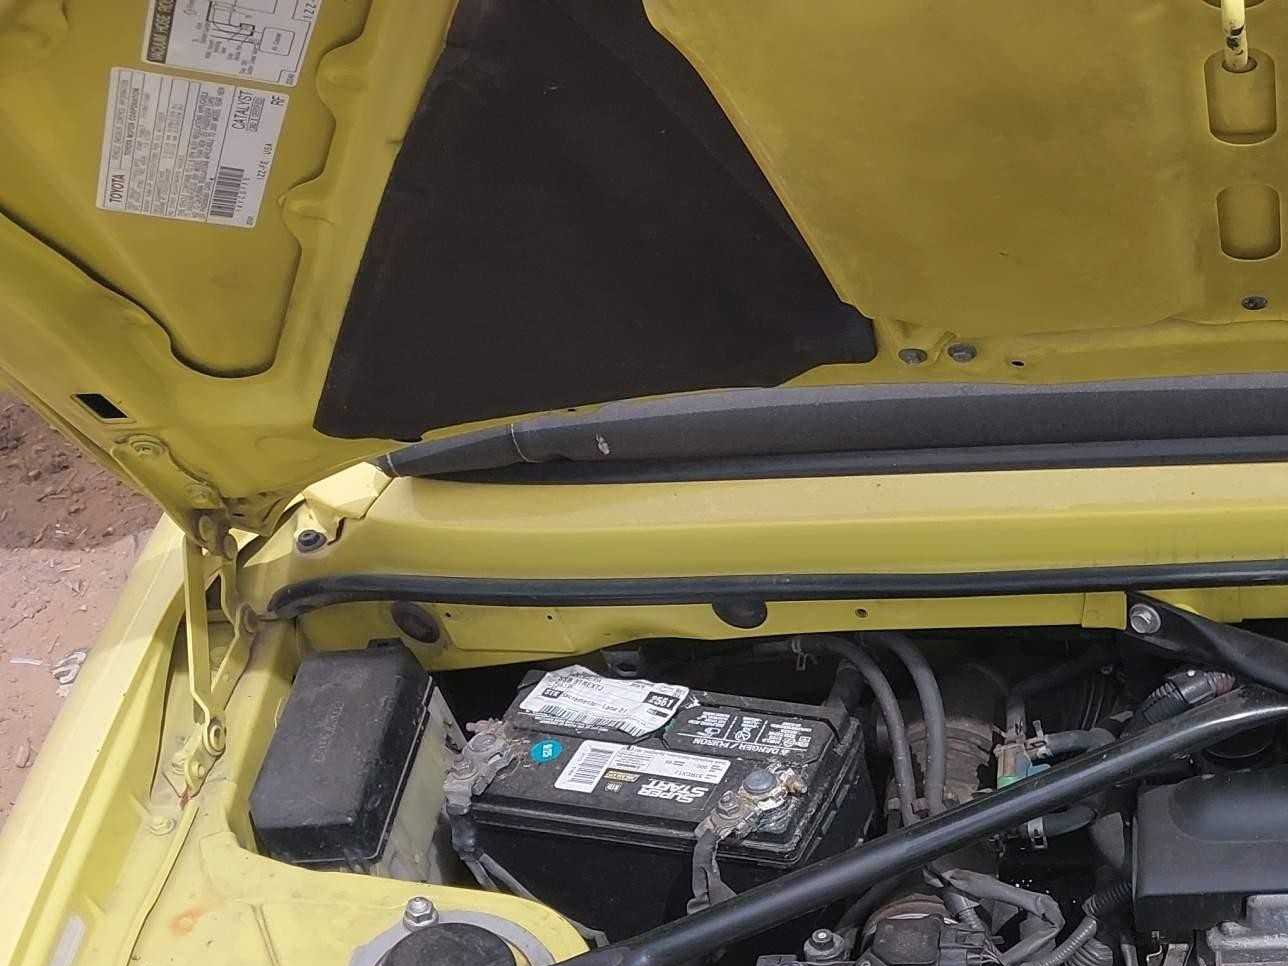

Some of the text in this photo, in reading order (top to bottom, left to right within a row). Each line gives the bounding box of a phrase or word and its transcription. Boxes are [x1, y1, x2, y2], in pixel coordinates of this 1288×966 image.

[231, 90, 252, 130] CATALYST
[270, 95, 285, 107] RF
[109, 174, 125, 203] TOYOTA
[738, 742, 781, 755] DANGER
[637, 784, 695, 804] SUPER
[649, 778, 710, 800] START
